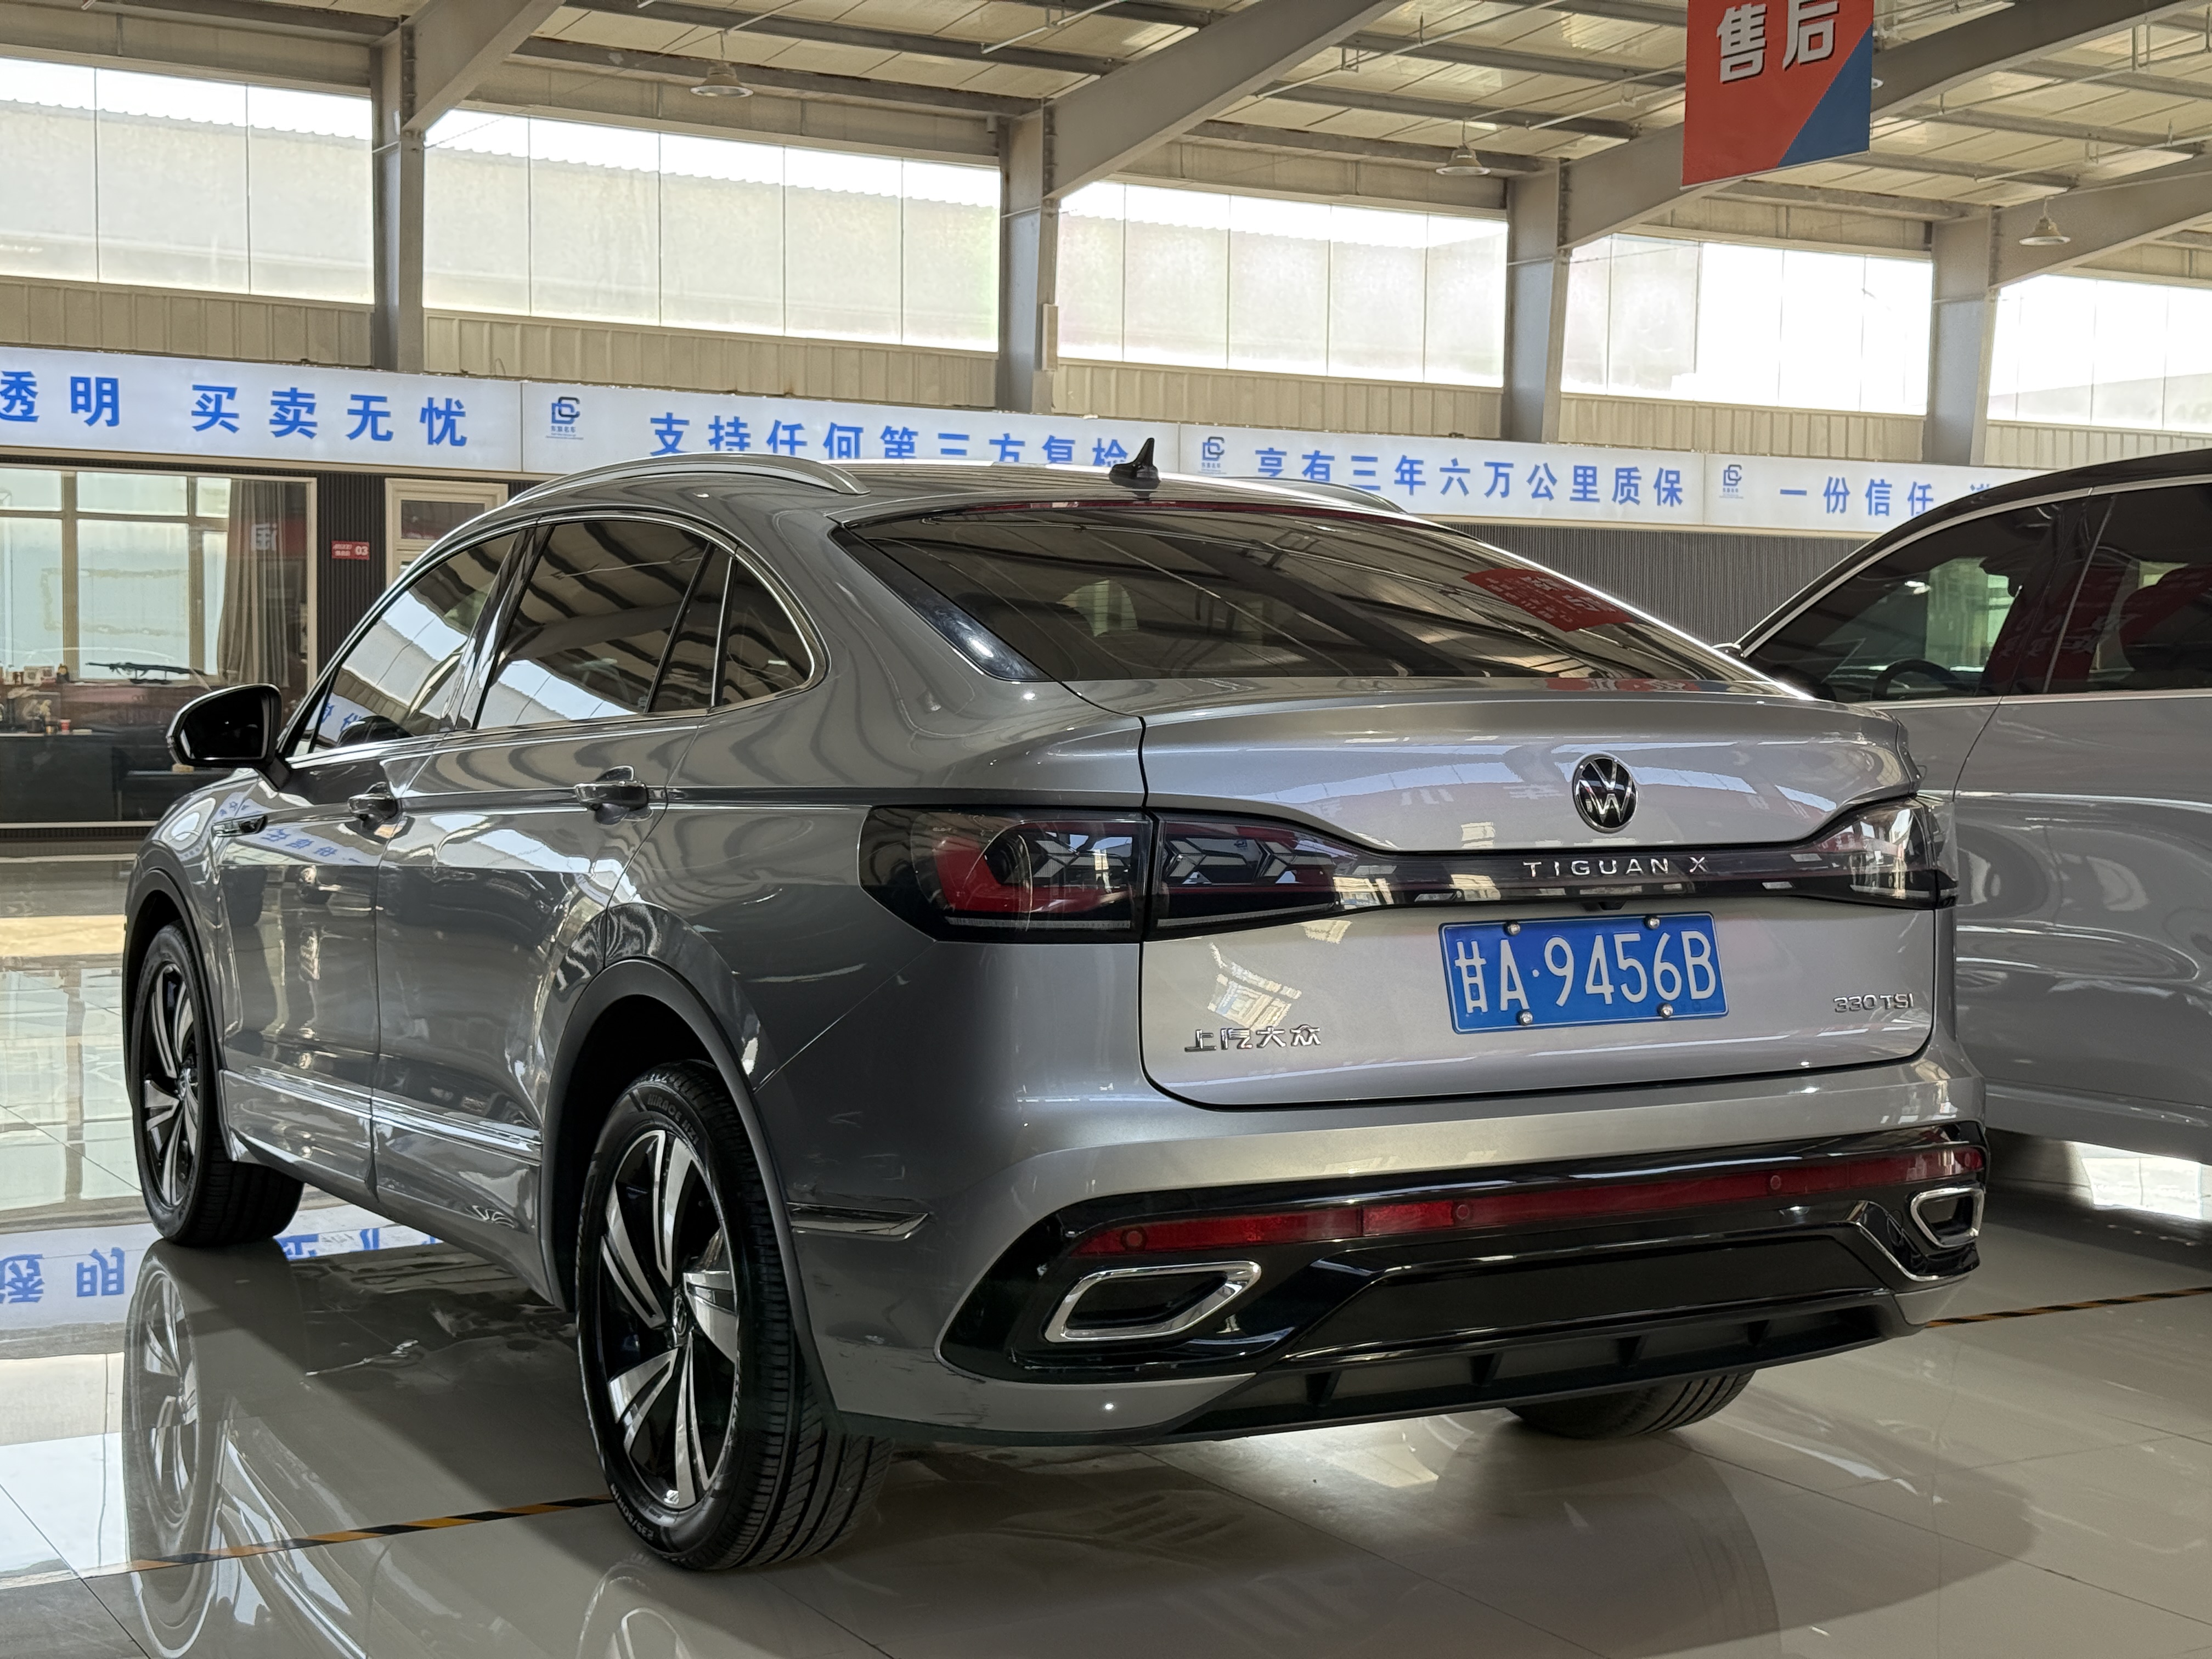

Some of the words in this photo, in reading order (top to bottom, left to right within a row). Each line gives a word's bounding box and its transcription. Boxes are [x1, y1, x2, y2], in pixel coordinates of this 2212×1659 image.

[1717, 0, 1839, 84] 售后
[0, 371, 121, 427] 透明
[191, 384, 468, 447] 买卖无忧
[1255, 447, 1684, 507] 享有三年六万公里质保
[1780, 476, 1935, 517] 一份信任
[355, 545, 369, 556] 03
[1523, 857, 1669, 877] TIGUAN
[1689, 856, 1708, 873] X
[1184, 1024, 1322, 1053] 上汽大众
